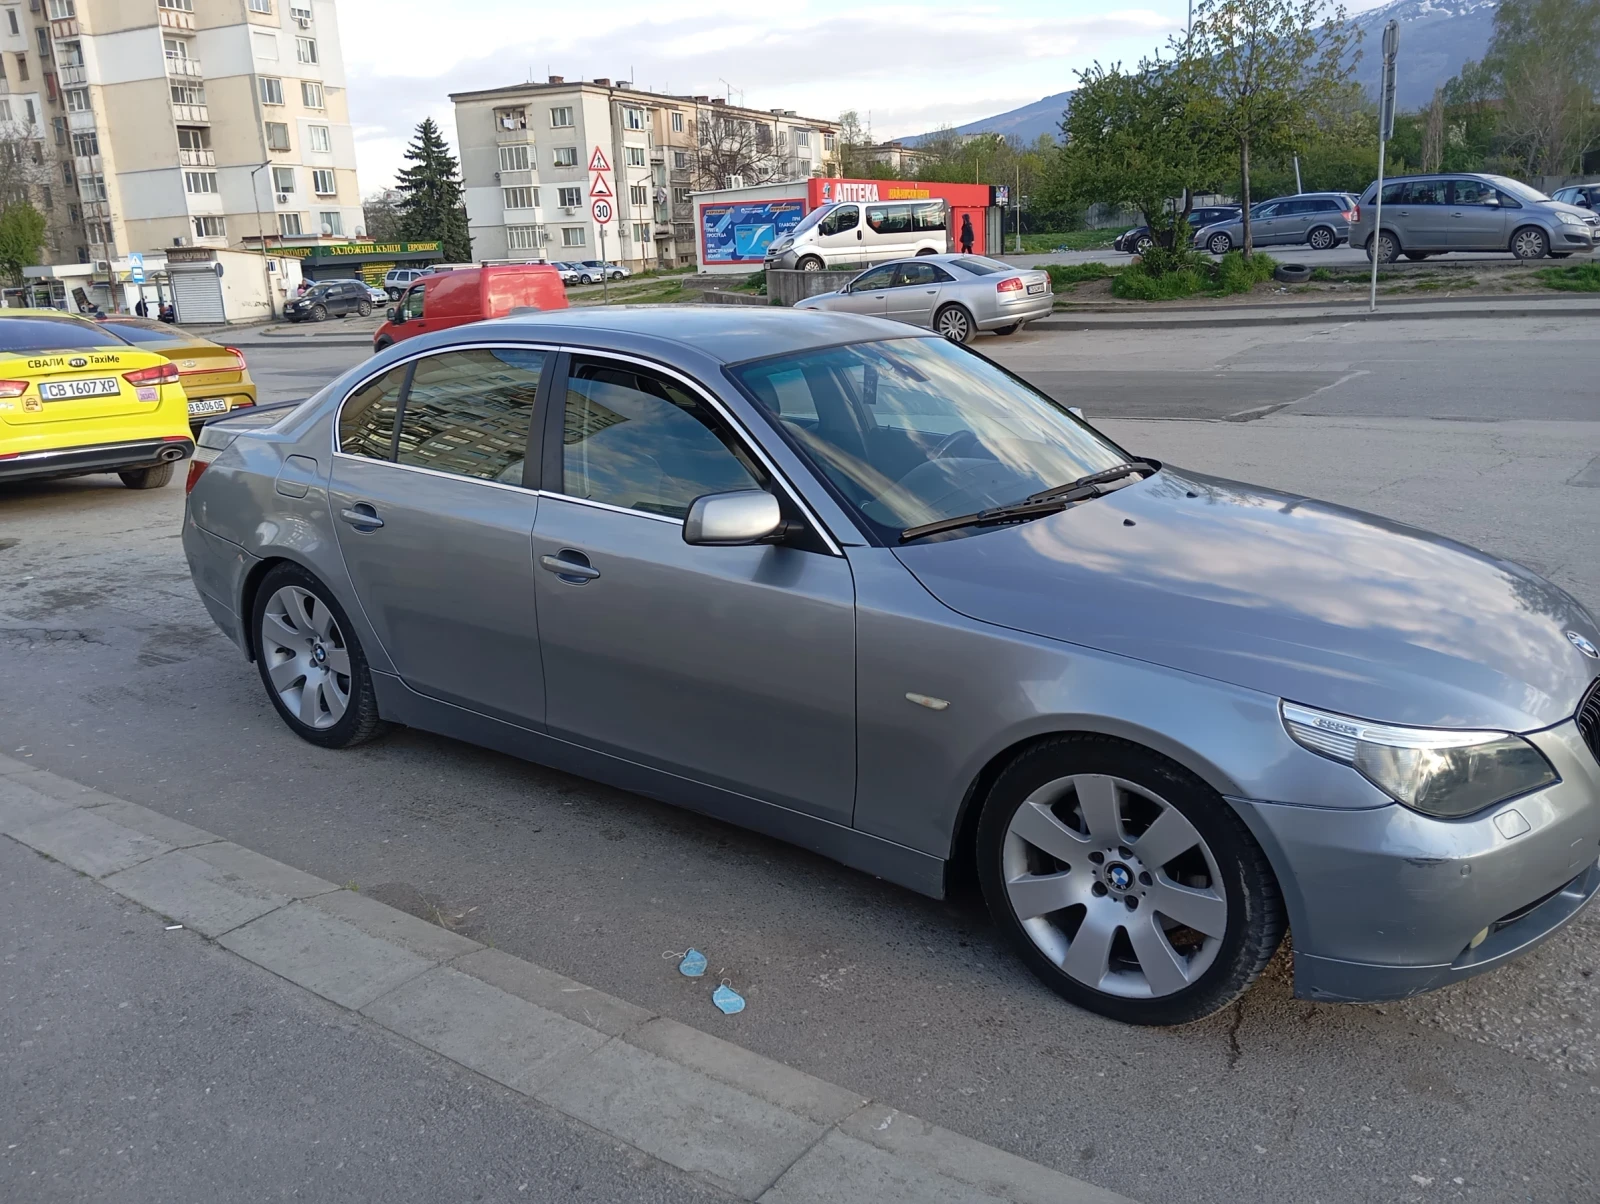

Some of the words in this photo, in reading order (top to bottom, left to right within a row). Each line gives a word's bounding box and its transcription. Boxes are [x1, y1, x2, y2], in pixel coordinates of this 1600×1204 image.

[835, 183, 879, 202] АПТЕКА
[595, 204, 609, 218] 30
[331, 245, 374, 256] ЗАЛОЖНИ
[376, 244, 401, 254] КЪЩИ
[407, 242, 439, 251] ЕВРОКОМЕРС
[28, 357, 64, 368] СВАЛИ
[89, 355, 120, 364] TaxiMe
[69, 381, 97, 395] 1607
[195, 401, 214, 412] 8306
